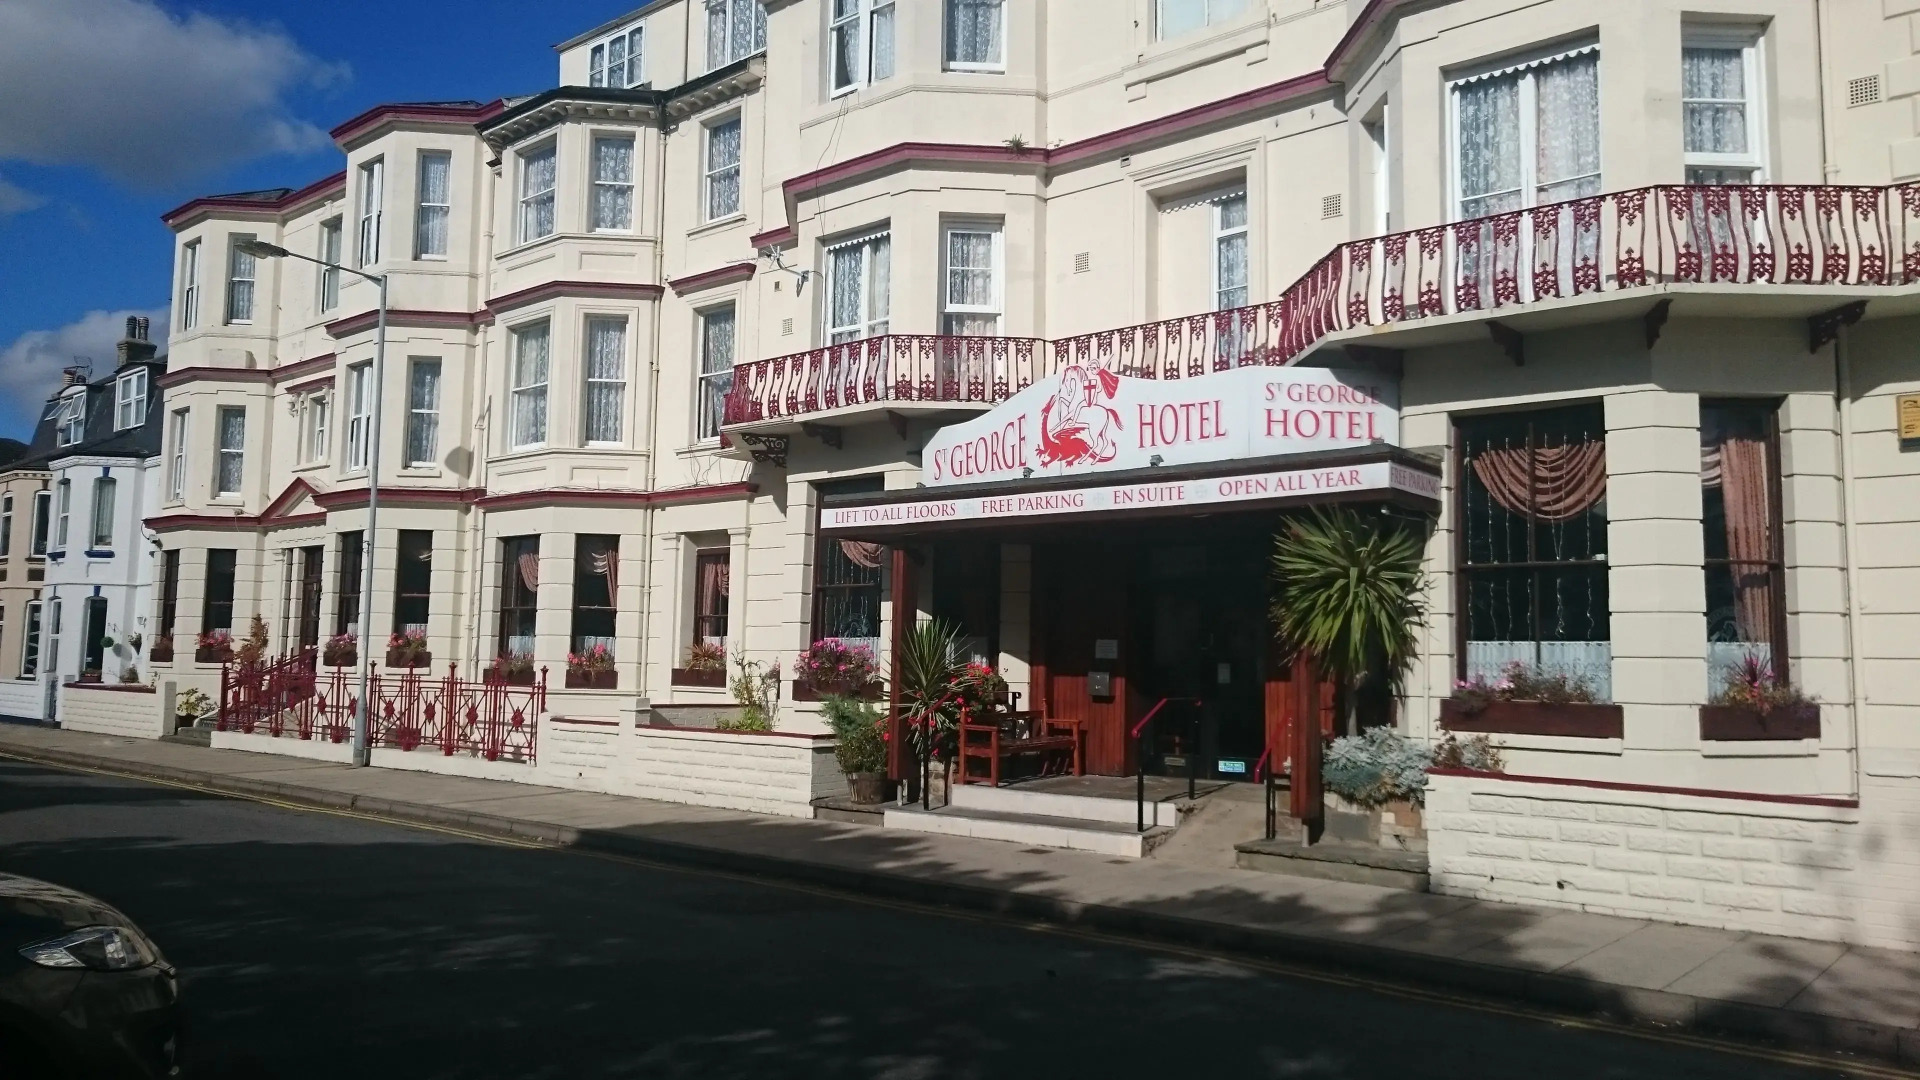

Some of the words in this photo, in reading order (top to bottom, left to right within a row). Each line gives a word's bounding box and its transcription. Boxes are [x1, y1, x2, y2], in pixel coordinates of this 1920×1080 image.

[1287, 383, 1380, 405] GEORGE
[950, 413, 1028, 478] GEORGE
[1137, 400, 1227, 449] HOTEL
[1264, 408, 1382, 439] HOTEL
[835, 510, 859, 524] LIFT
[862, 509, 879, 522] TO
[882, 508, 902, 521] ALL
[907, 503, 956, 519] FLOORS
[981, 498, 1013, 514] FREE
[1018, 493, 1084, 511] PARKING
[1113, 489, 1133, 505] EN
[1138, 485, 1185, 503] SUITE
[1219, 477, 1268, 497] OPEN
[1274, 474, 1308, 492] ALL
[1312, 469, 1363, 489] YEAR
[1391, 466, 1408, 486] FREE
[1409, 472, 1439, 496] PARKING
